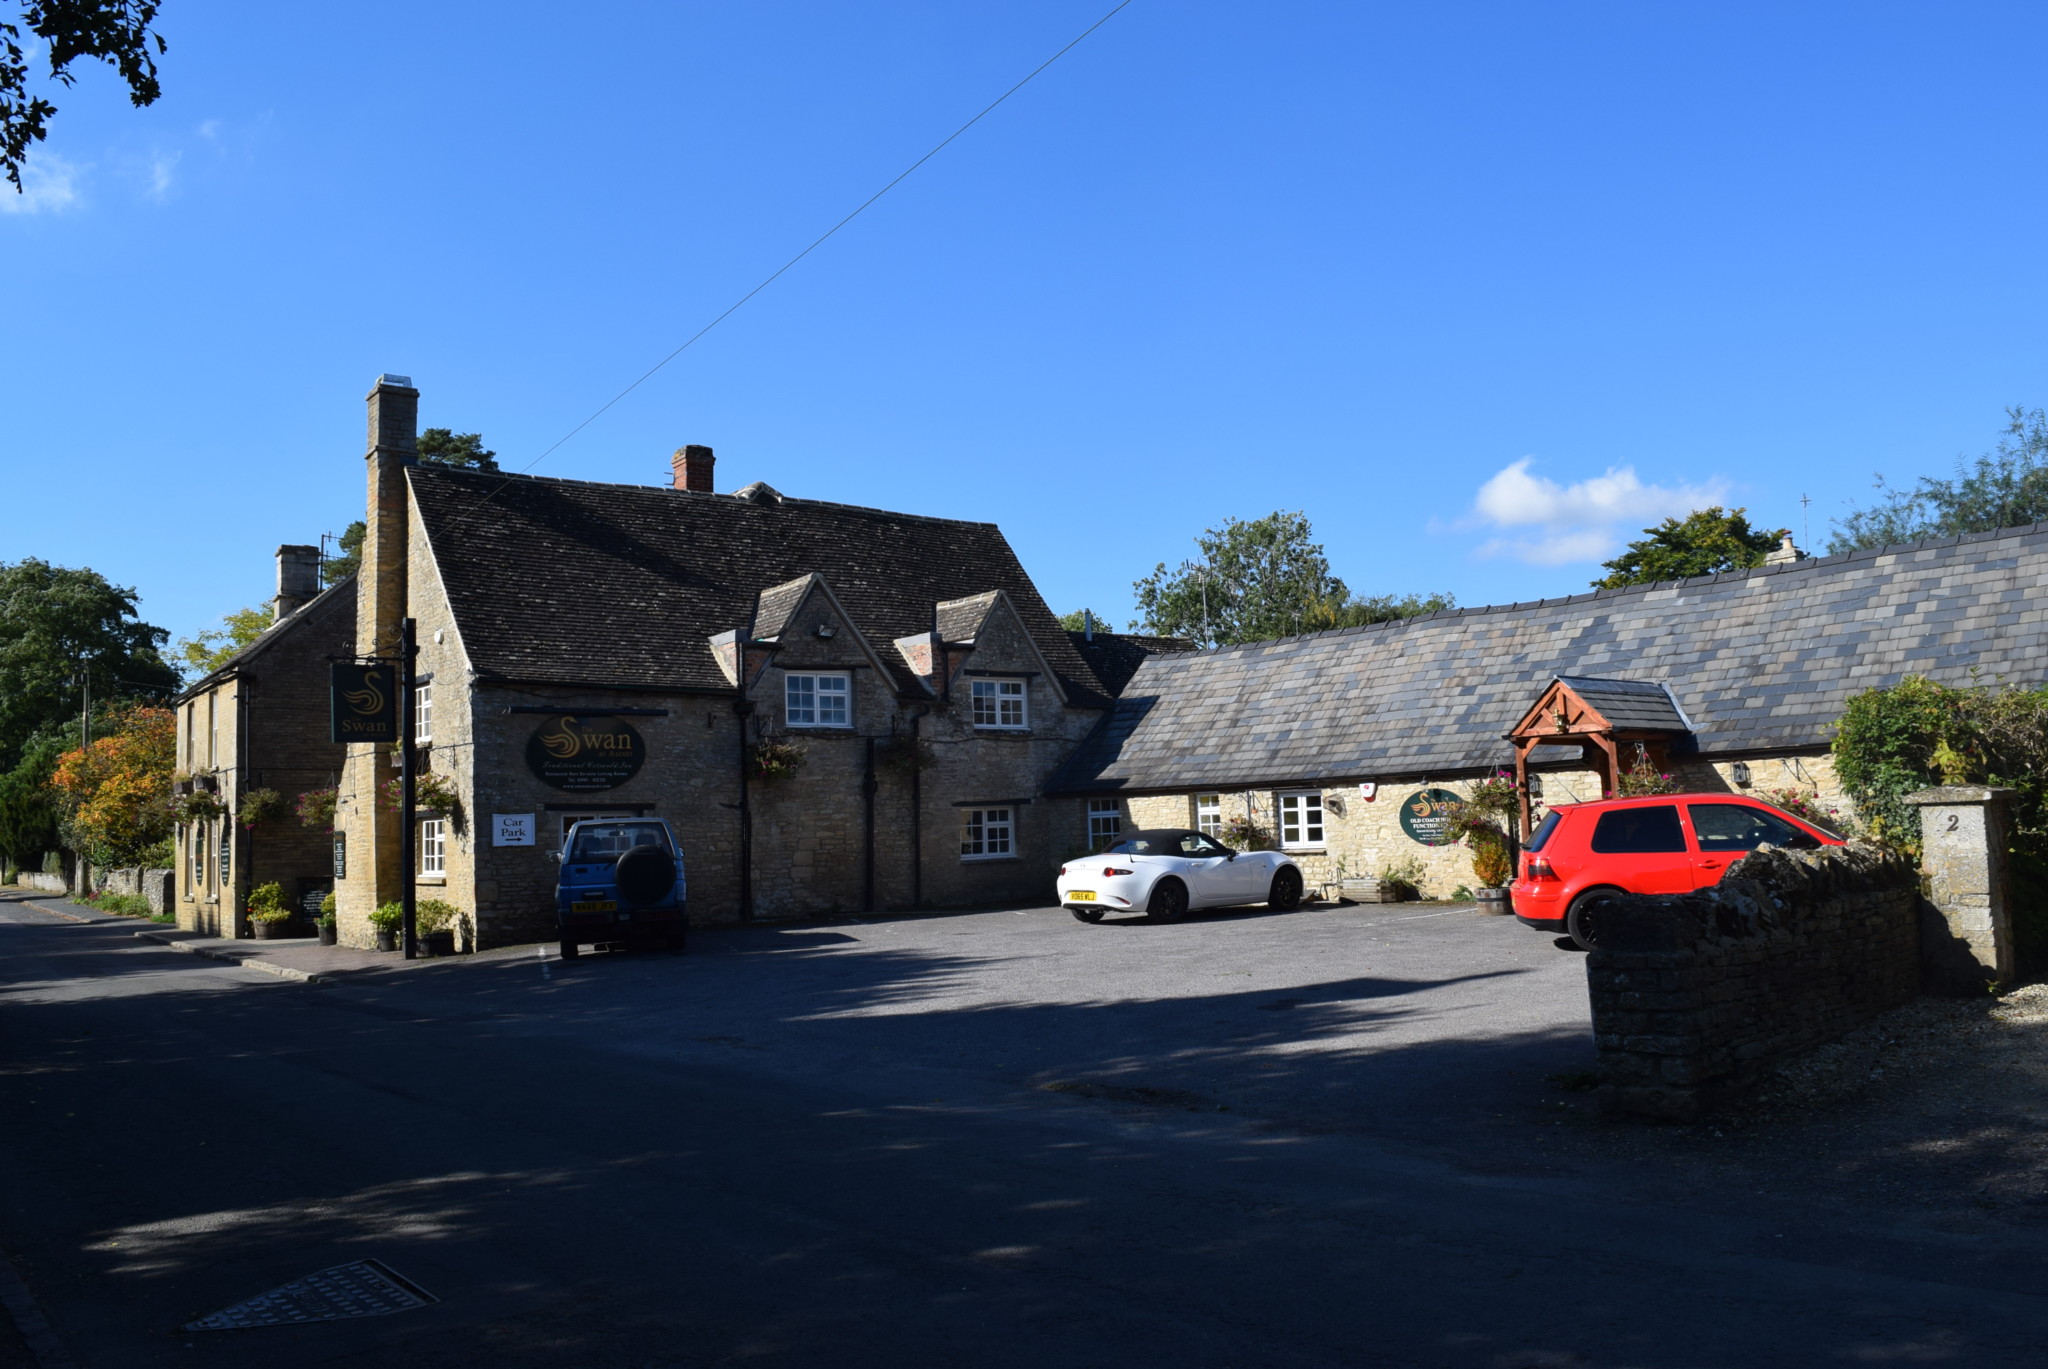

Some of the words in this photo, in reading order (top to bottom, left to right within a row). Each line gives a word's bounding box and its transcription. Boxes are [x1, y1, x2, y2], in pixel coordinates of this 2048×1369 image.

[342, 719, 387, 732] Swan
[503, 818, 523, 827] Car
[1947, 814, 1959, 832] 2
[501, 828, 526, 837] Park
